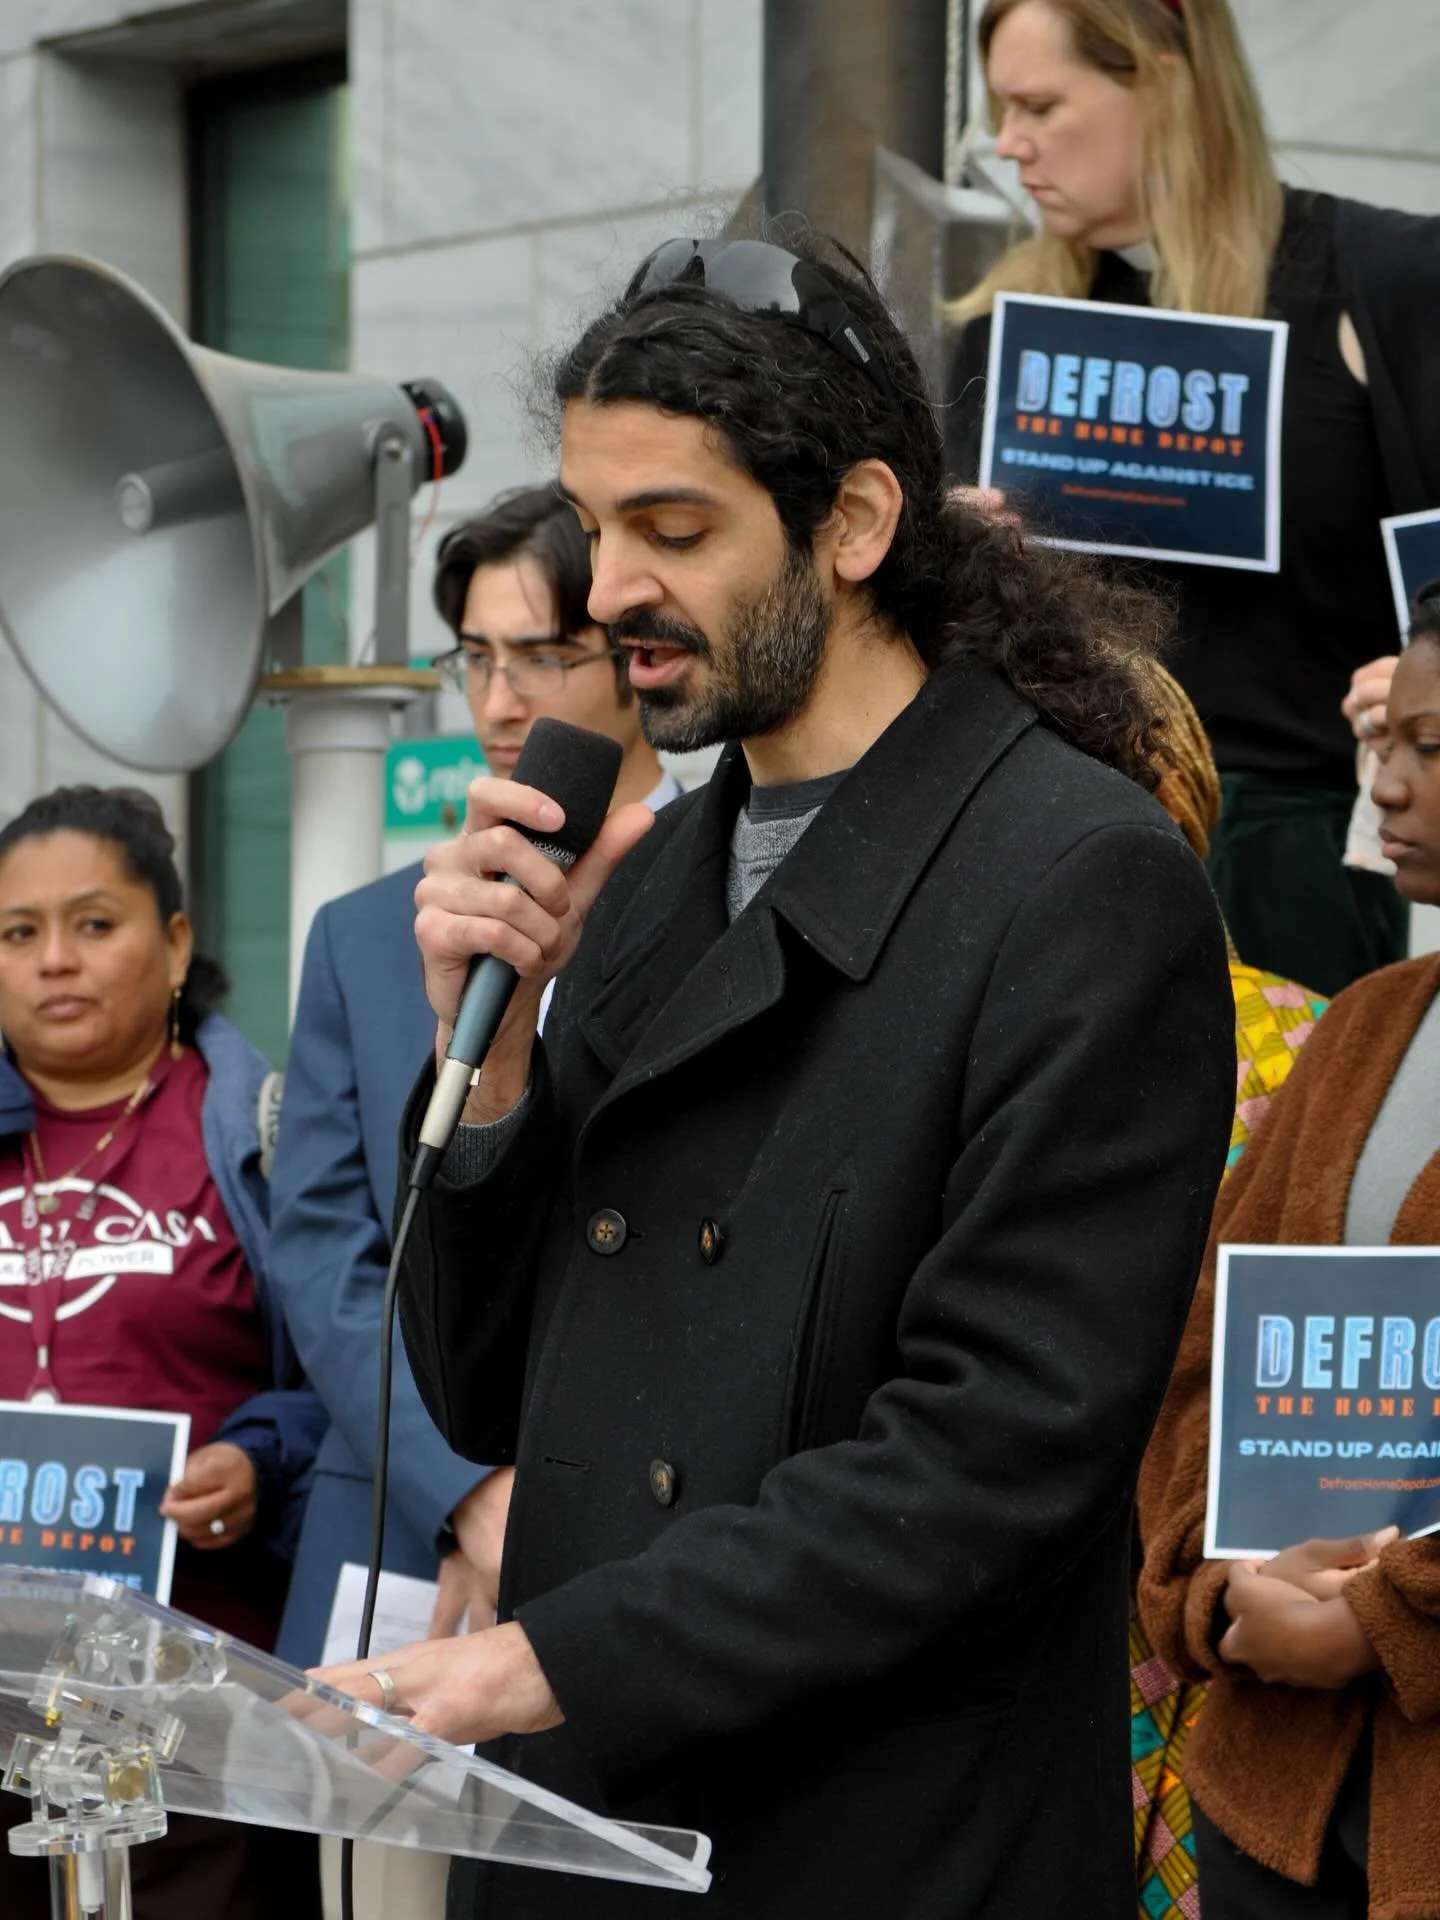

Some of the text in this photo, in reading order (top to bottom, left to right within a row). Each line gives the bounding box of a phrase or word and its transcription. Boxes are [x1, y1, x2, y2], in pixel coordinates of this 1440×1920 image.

[1017, 350, 1248, 434] DEFROST
[1016, 416, 1243, 456] THE HOME DEPOT
[1003, 449, 1253, 489] STAND UP AGAINST ICE
[1256, 1396, 1315, 1416] THE
[1335, 1397, 1415, 1417] HOME
[1239, 1438, 1440, 1460] STAND UP AGAI
[41, 1529, 136, 1556] DEPOT
